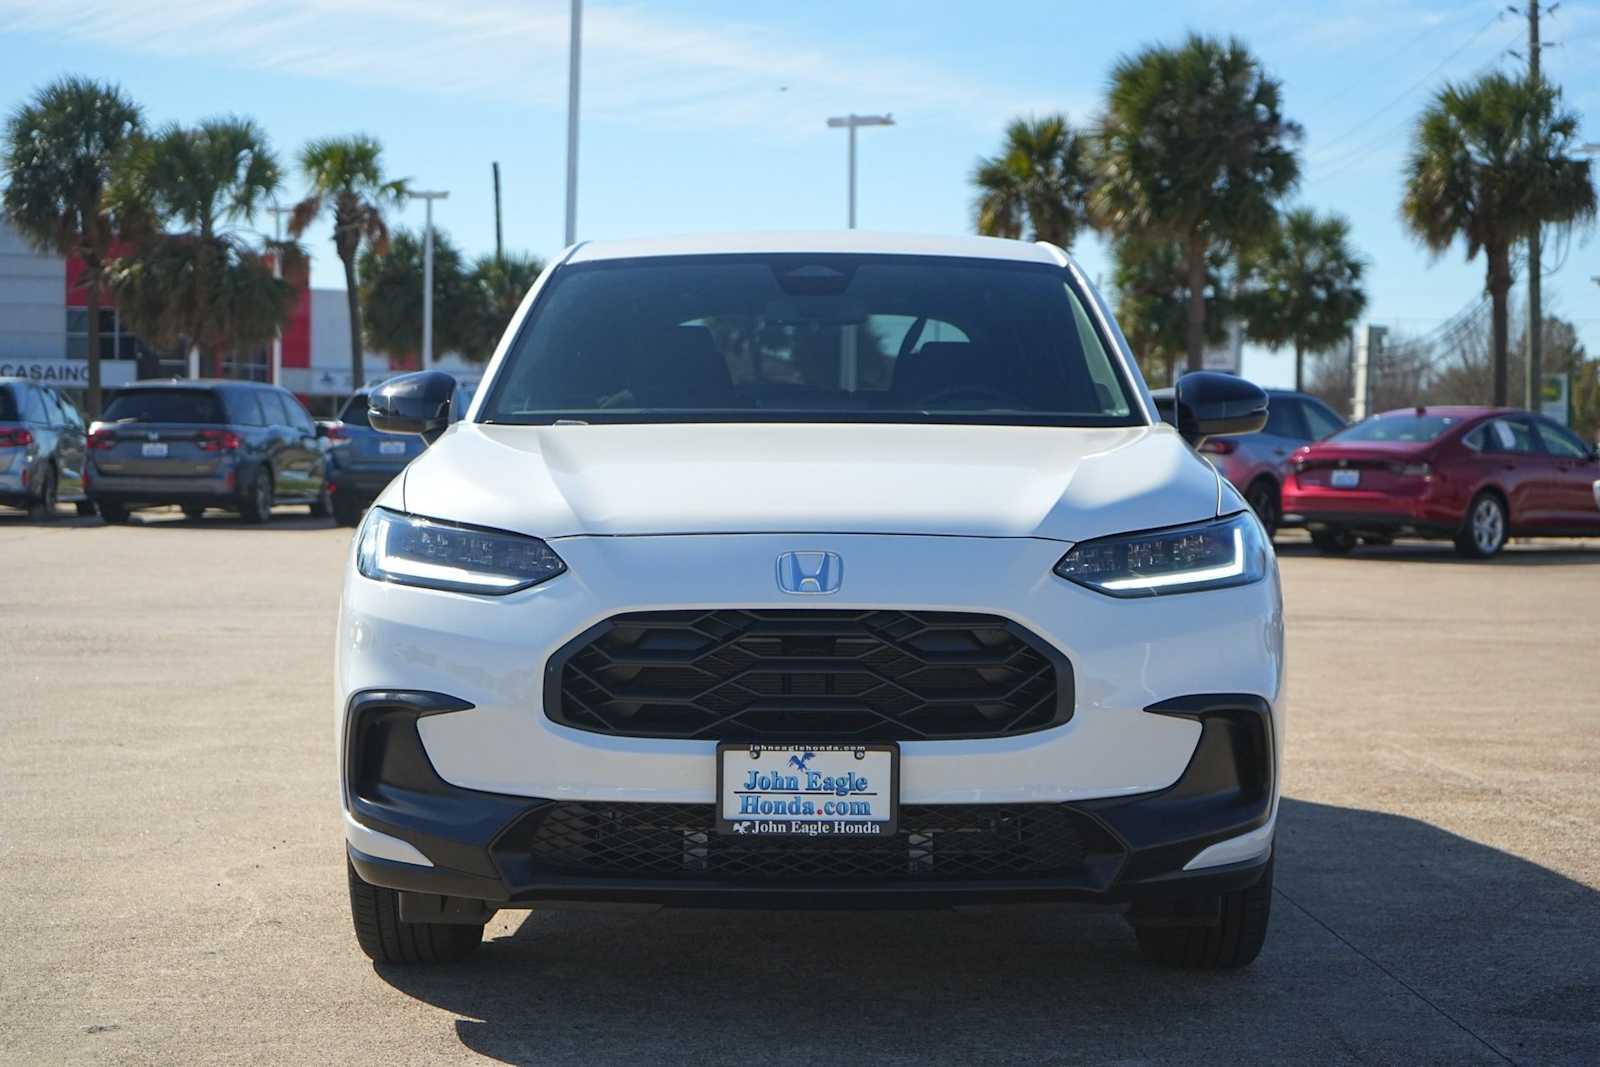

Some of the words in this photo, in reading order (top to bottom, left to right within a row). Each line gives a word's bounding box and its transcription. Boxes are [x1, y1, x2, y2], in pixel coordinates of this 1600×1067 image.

[743, 769, 799, 791] John
[804, 769, 868, 796] Eagle
[738, 795, 872, 816] Honda.com
[751, 821, 787, 834] John
[791, 822, 830, 836] Eagle
[833, 822, 881, 834] Honda
